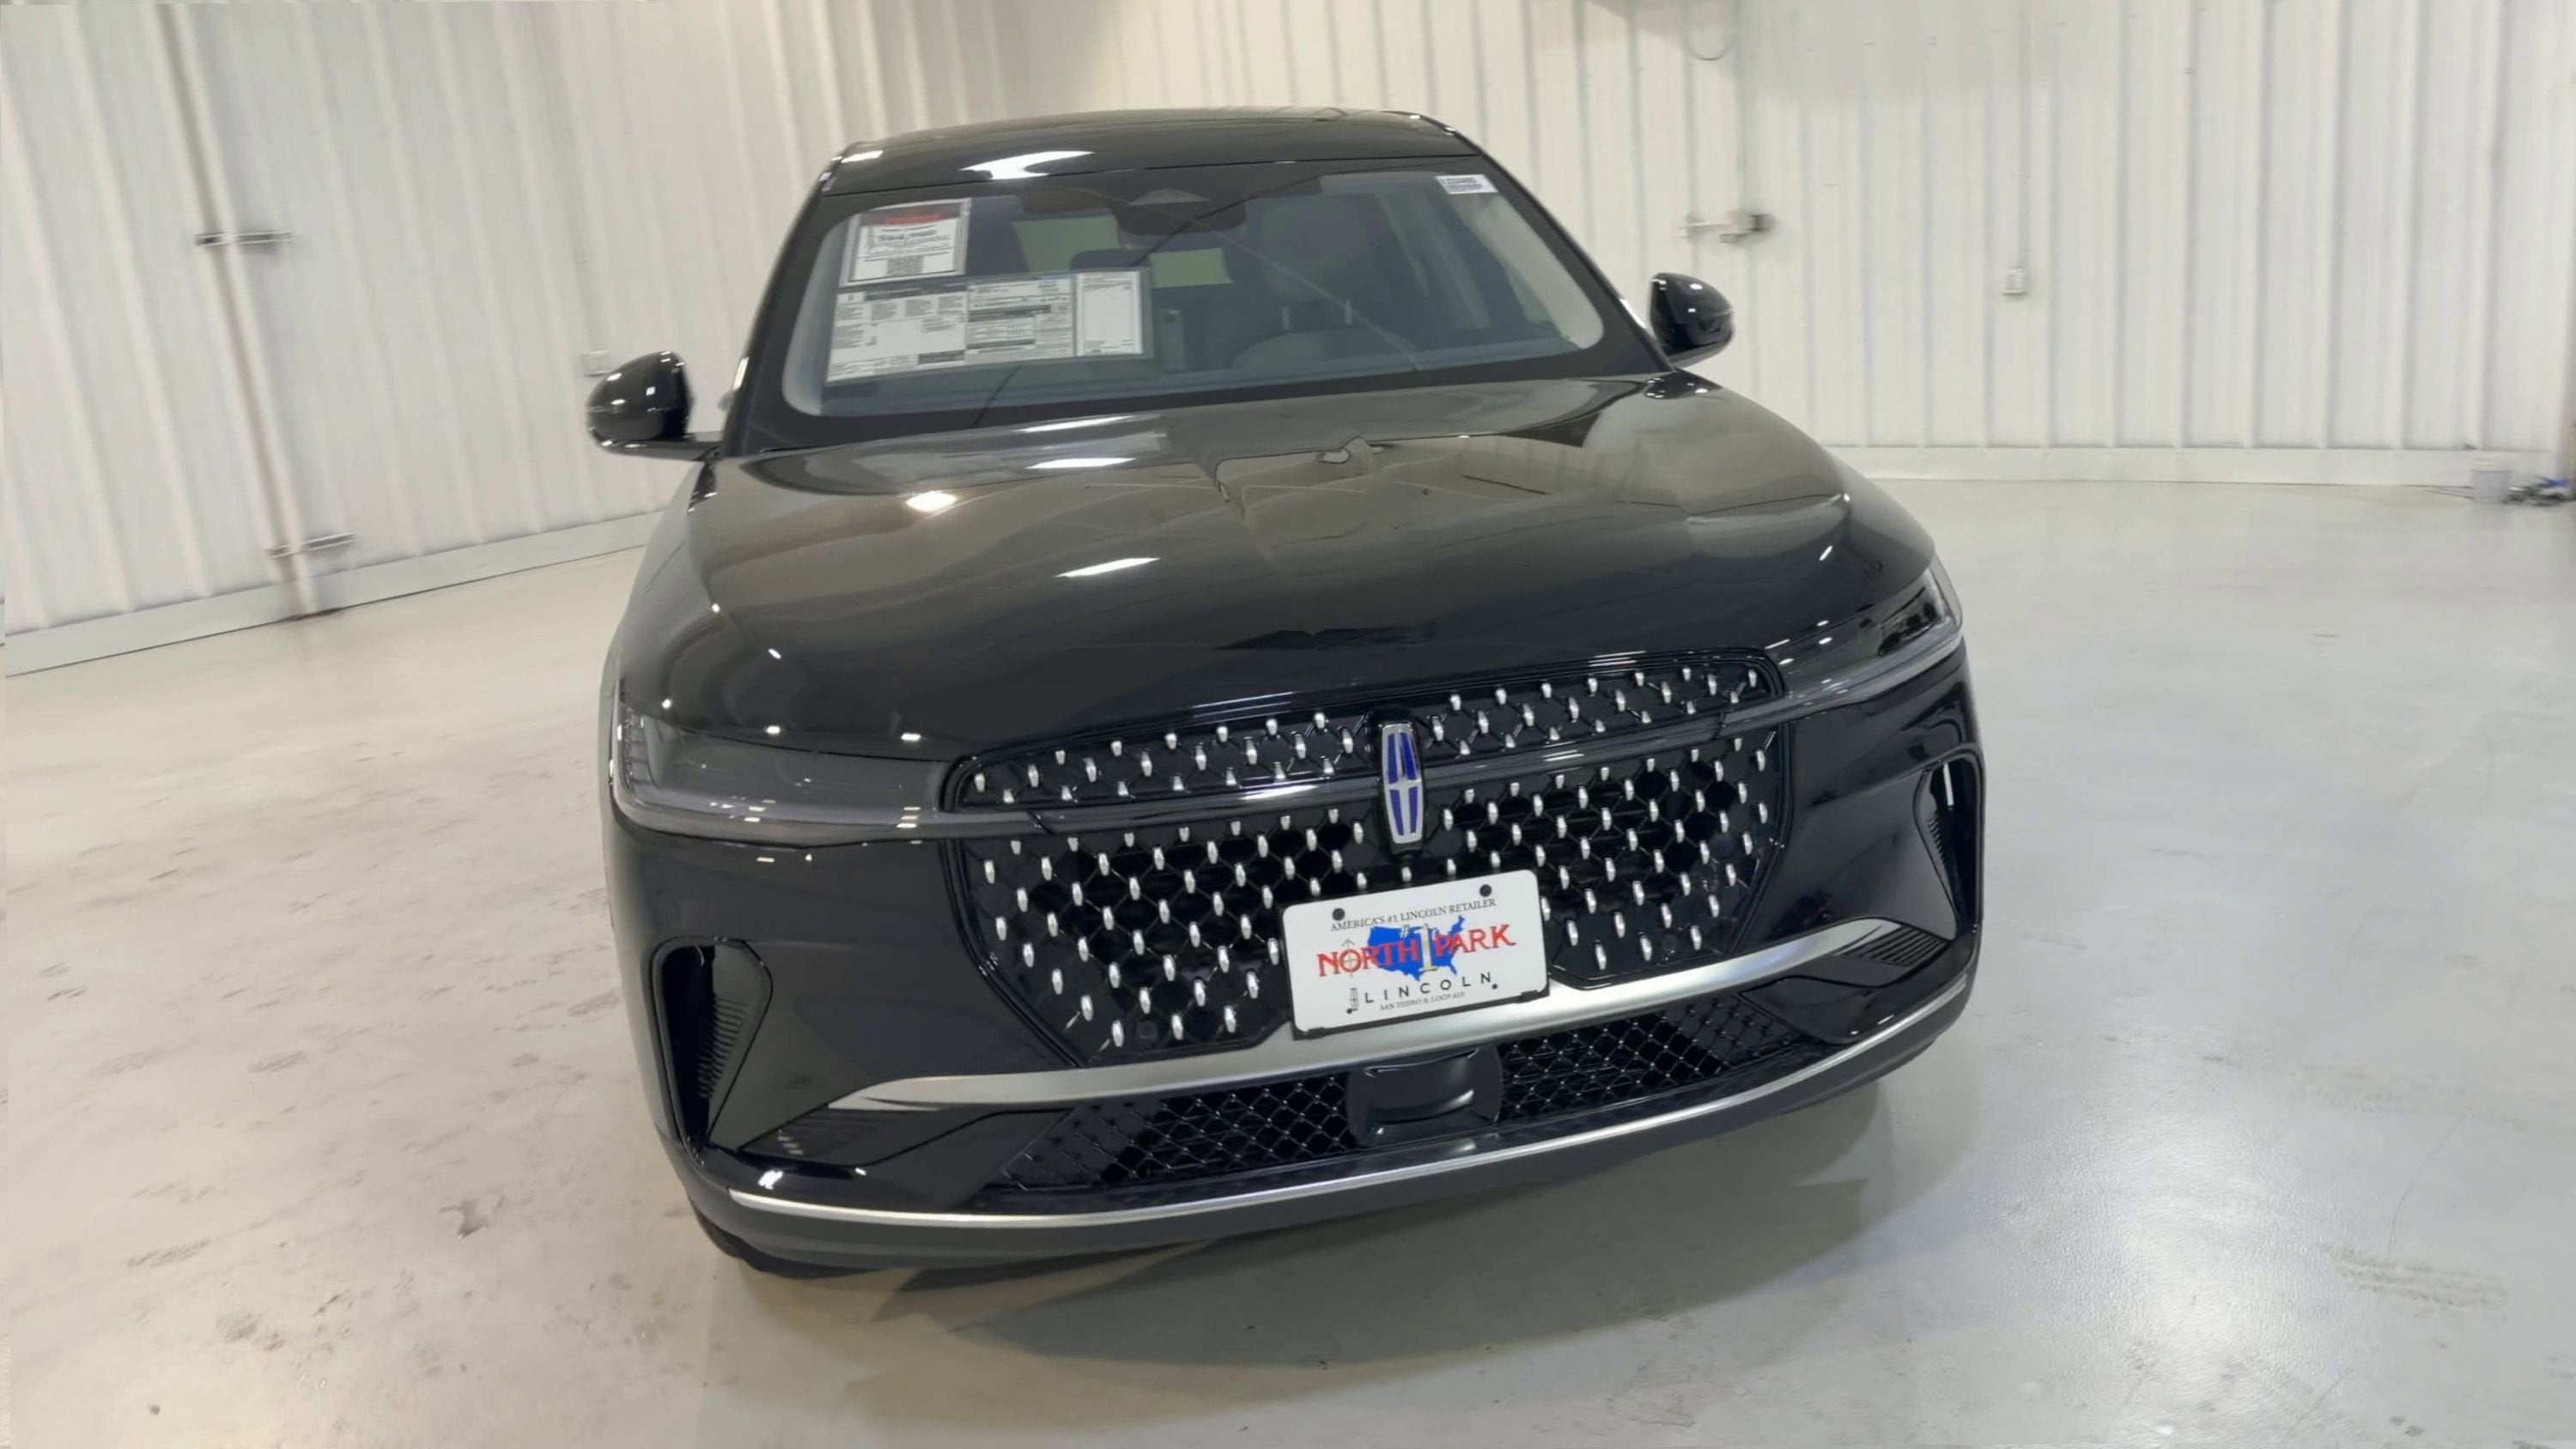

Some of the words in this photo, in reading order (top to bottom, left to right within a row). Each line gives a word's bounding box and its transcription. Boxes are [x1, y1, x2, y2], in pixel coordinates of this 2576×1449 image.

[1330, 915, 1385, 931] AMERICA'S
[1400, 905, 1447, 921] LINCOLN
[1449, 898, 1497, 913] RETAILER
[1316, 939, 1419, 977] NORTH
[1433, 925, 1516, 958] PARK
[1364, 972, 1492, 1003] LINCOLN
